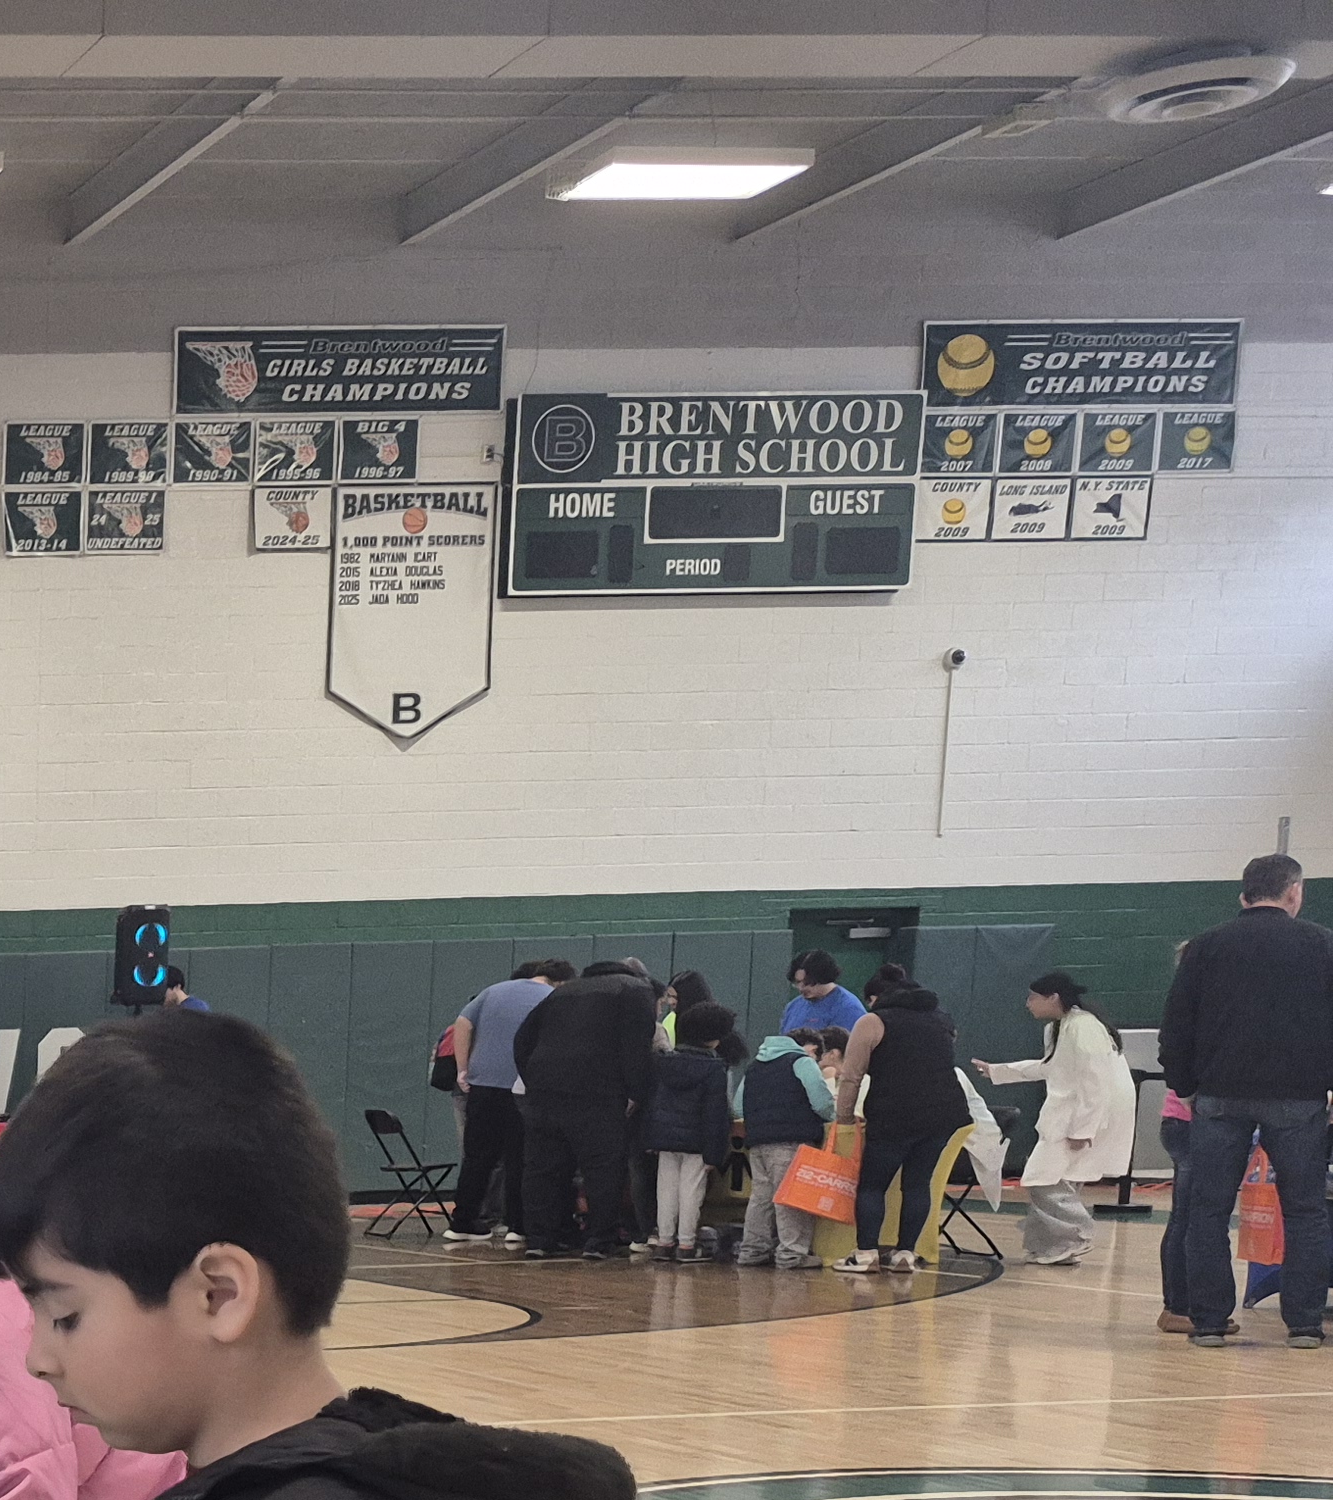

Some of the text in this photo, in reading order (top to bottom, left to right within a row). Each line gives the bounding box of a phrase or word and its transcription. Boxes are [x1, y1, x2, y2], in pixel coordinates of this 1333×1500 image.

[1053, 332, 1187, 347] Brentwood
[310, 338, 448, 354] Brentwood
[1020, 351, 1217, 370] SOFTBALL
[265, 357, 488, 377] GIRLS BASKETBALL
[1025, 375, 1208, 394] CHAMPIONS
[282, 382, 471, 401] CHAMPIONS
[617, 399, 903, 436] BRENTWOOD
[935, 416, 986, 427] LEAGUE
[1016, 415, 1065, 427] LEAGUE
[1095, 414, 1146, 425] LEAGUE
[1174, 414, 1223, 424] LEAGUE
[20, 425, 72, 436] LEAGUE
[356, 421, 406, 432] BIG 4
[613, 438, 905, 475] HIGH SCHOOL
[940, 461, 971, 471] 2007
[1020, 461, 1052, 471] 2008
[1098, 460, 1133, 470] 2009
[1177, 458, 1213, 468] 2017
[20, 471, 70, 483] 1984-85
[355, 467, 405, 478] 1996-97
[932, 482, 981, 493] COUNTY
[999, 484, 1068, 496] LONG ISLAND
[1079, 480, 1148, 491] N.Y. STATE
[17, 493, 69, 505] LEAGUE
[96, 493, 148, 504] LEAGUE
[266, 490, 319, 500] COUNTY
[343, 492, 488, 520] BASKETBALL
[549, 493, 615, 518] HOME
[810, 490, 884, 515] GUEST
[91, 514, 160, 525] 24 25
[934, 527, 970, 538] 2009
[1010, 523, 1045, 534] 2009
[1092, 525, 1126, 535] 2009
[17, 539, 67, 550] 2013-14
[87, 537, 162, 549] UNDEFEATED
[262, 535, 320, 546] 2024-25
[342, 535, 485, 549] 1,000 POINT SCORERS
[341, 552, 438, 563] 1982 MARYANN ICART
[339, 565, 443, 577] 2015 ALEXIA DOUGLAS
[666, 559, 721, 575] PERIOD
[339, 581, 360, 591] 2018
[410, 579, 445, 590] HAWKINS
[338, 593, 418, 605] 2025 JADA HOOD
[392, 692, 422, 723] B
